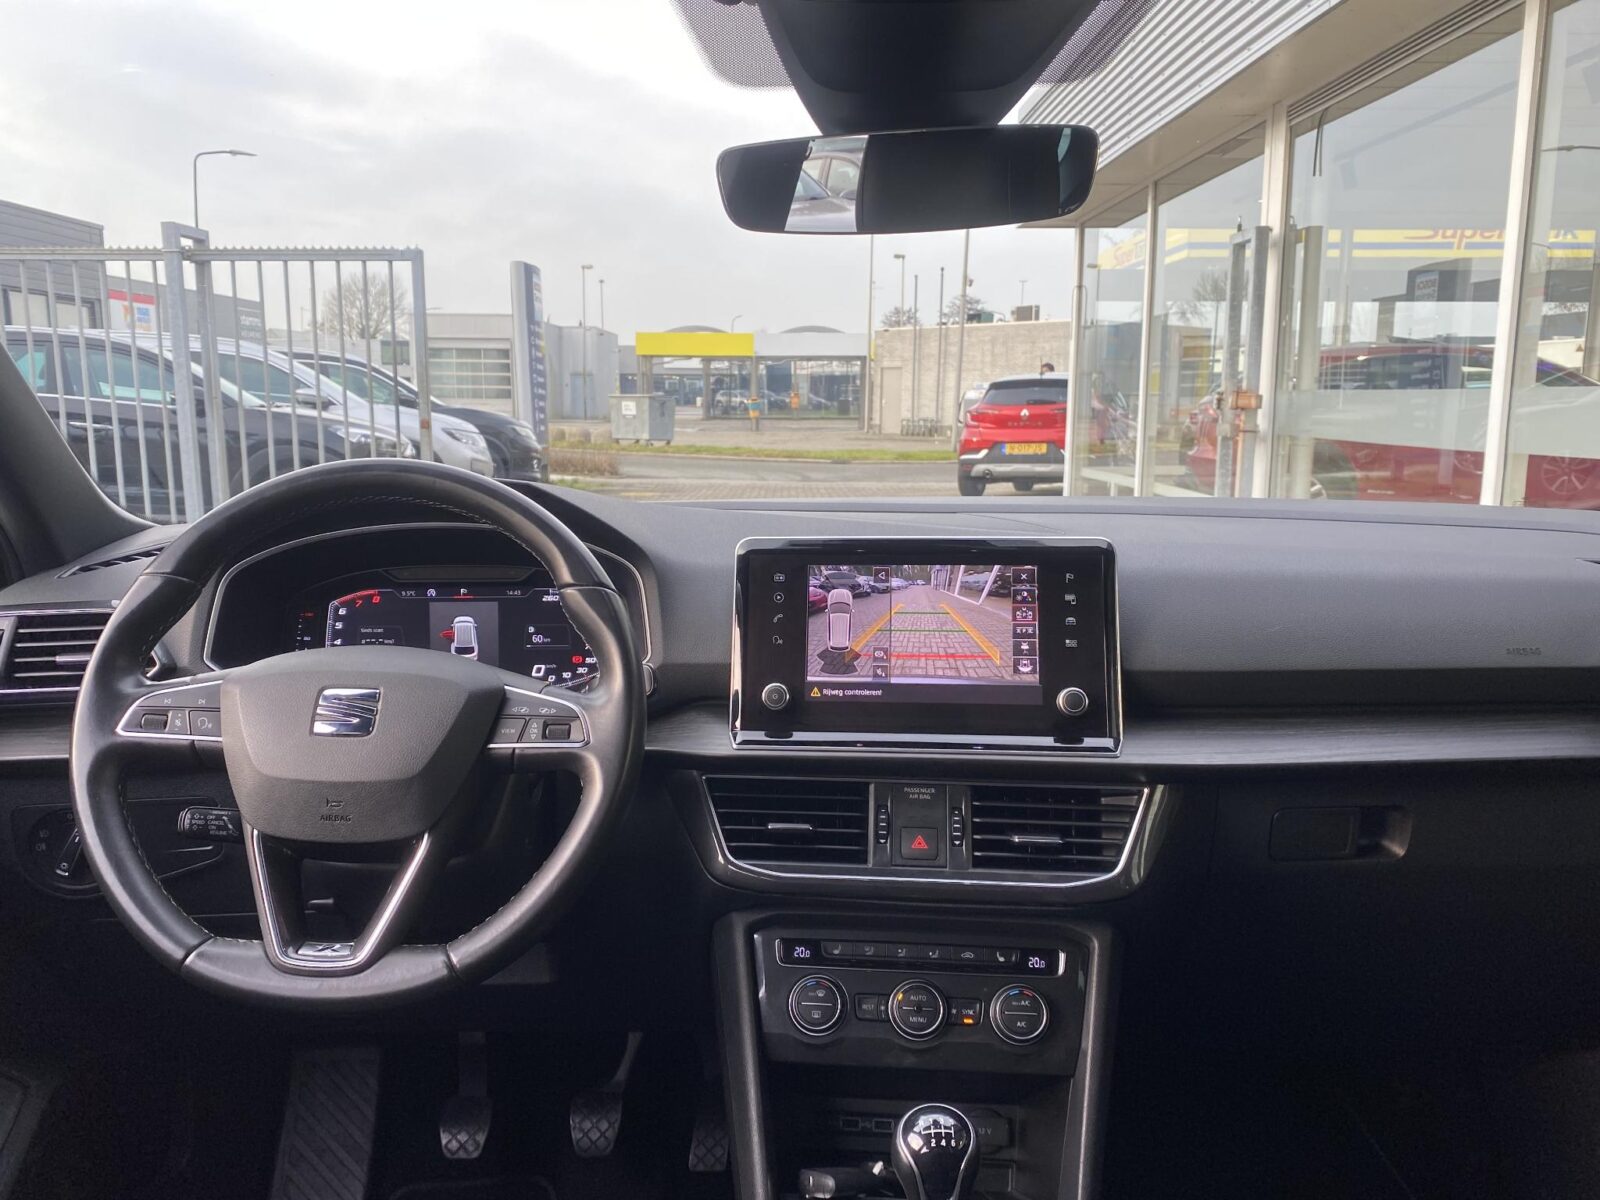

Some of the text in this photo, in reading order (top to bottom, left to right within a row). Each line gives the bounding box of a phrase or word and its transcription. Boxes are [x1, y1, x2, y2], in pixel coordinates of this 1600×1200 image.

[355, 600, 362, 608] 7
[532, 634, 543, 643] 60
[531, 664, 546, 677] 0
[822, 689, 843, 697] Rijweg
[903, 786, 935, 794] PASSENGER
[319, 814, 352, 823] AIRBAG
[794, 946, 811, 958] 20.0
[1028, 956, 1046, 968] 20.0
[930, 1138, 957, 1148] 2 4 6
